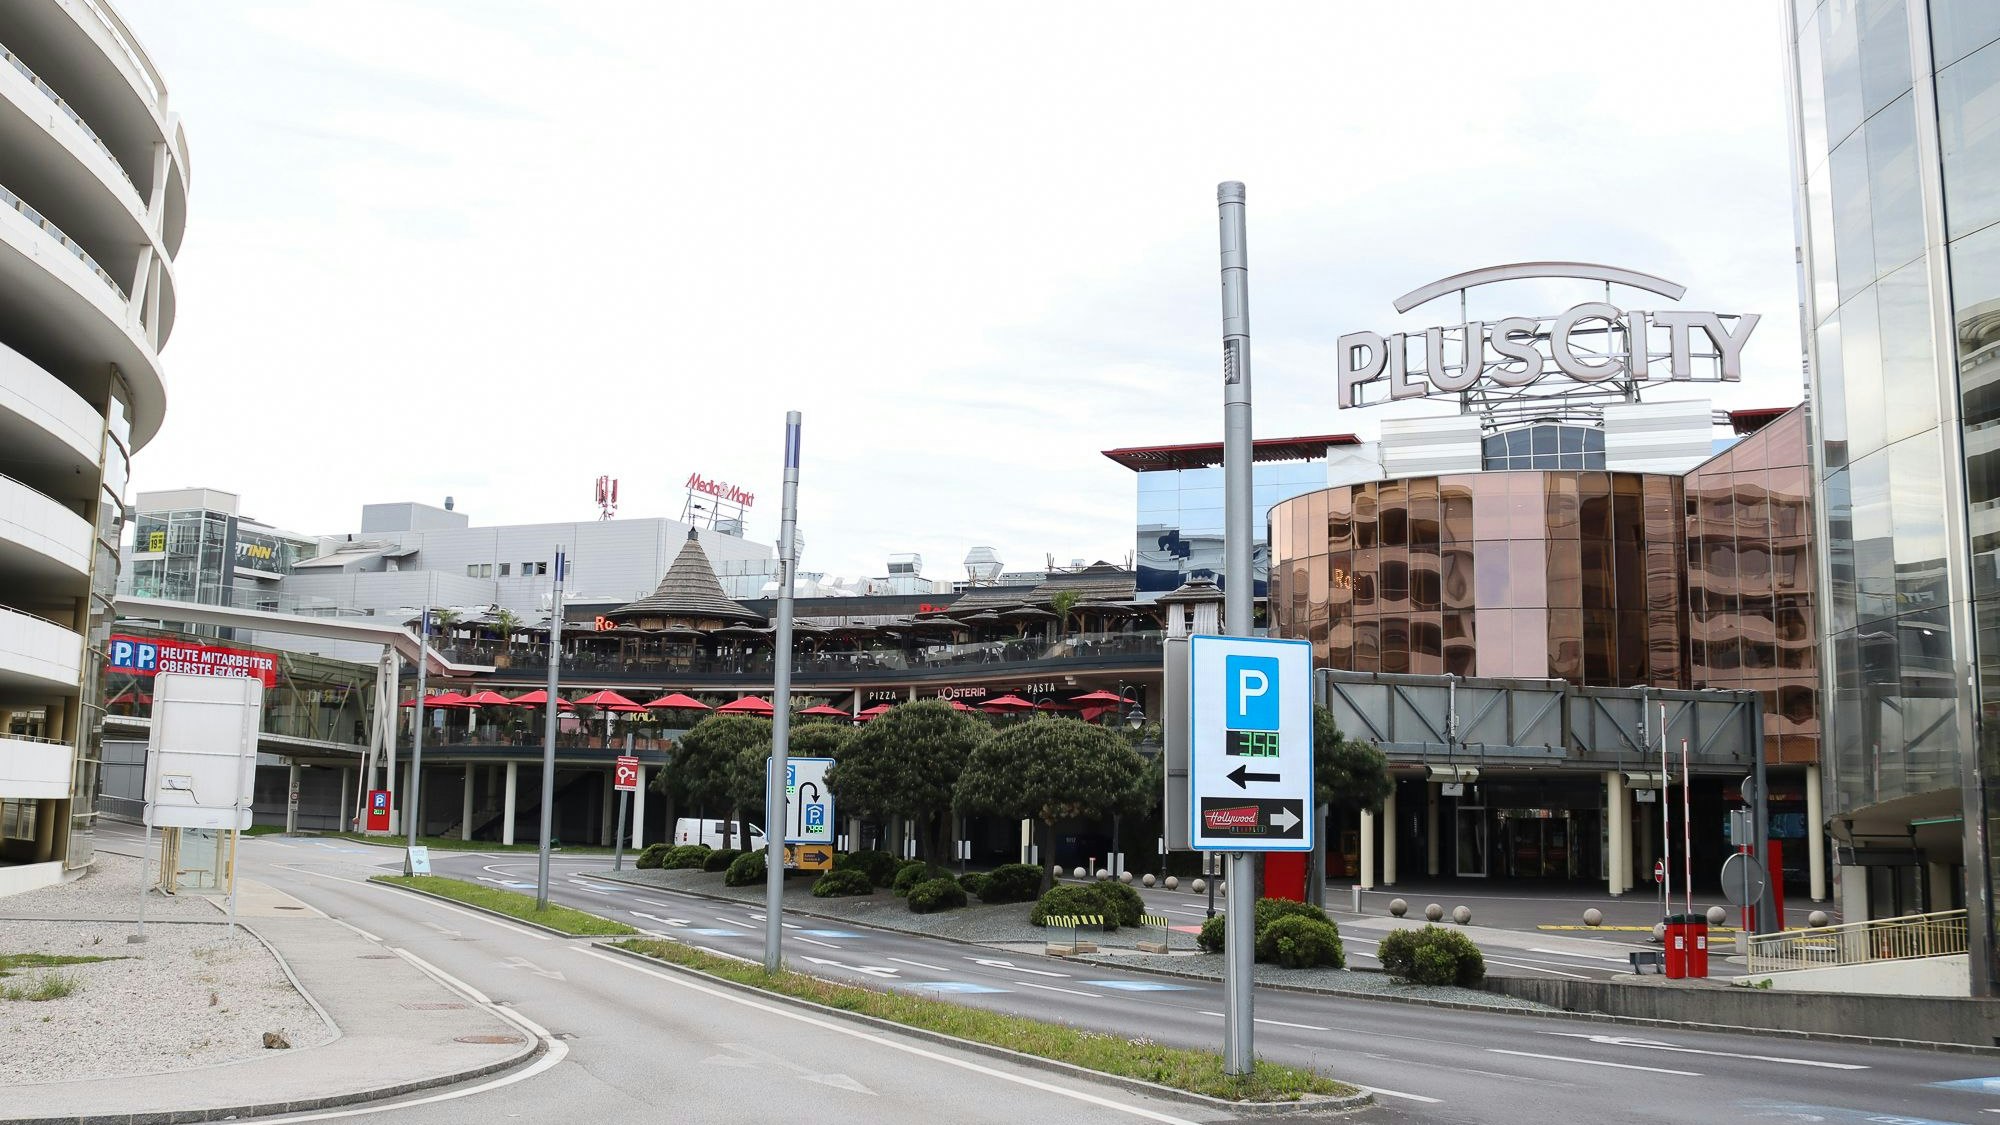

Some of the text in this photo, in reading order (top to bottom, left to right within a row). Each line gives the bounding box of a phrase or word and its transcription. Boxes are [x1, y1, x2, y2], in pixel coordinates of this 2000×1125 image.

[1337, 301, 1762, 410] PLUSCITY
[685, 472, 755, 507] Media Markt
[159, 660, 249, 678] OBERSTE ETAGE
[160, 646, 273, 670] HEUTE MITARBEITER
[869, 691, 897, 701] PIZZA
[1027, 682, 1056, 694] PASTA
[1239, 668, 1269, 716] P
[1239, 731, 1280, 757] 358
[1205, 812, 1256, 826] Hollywood
